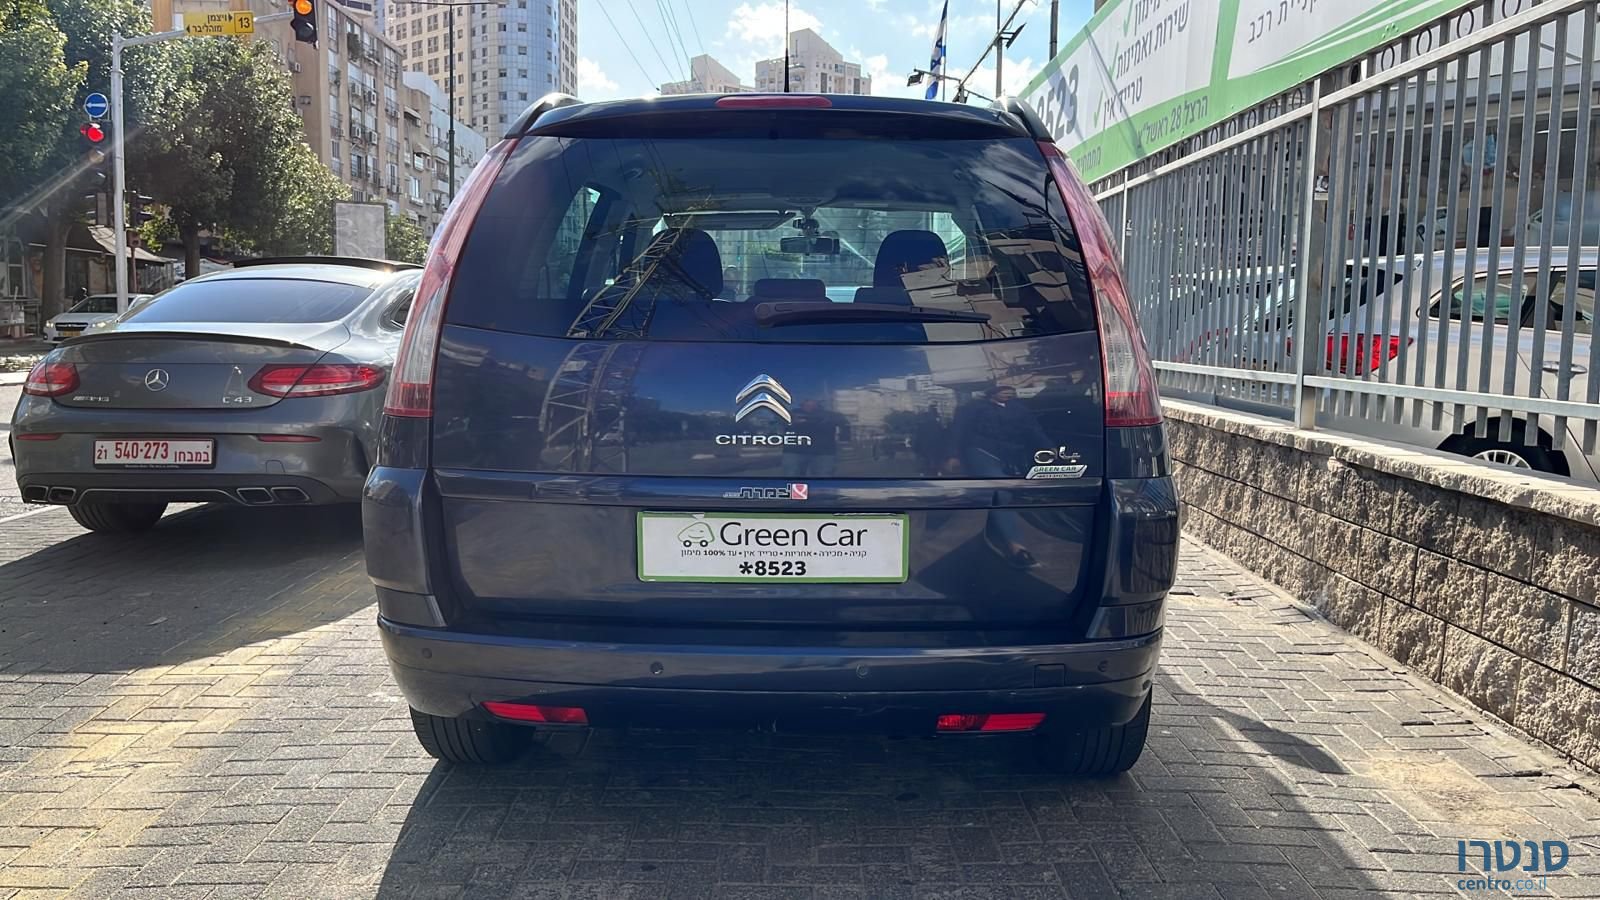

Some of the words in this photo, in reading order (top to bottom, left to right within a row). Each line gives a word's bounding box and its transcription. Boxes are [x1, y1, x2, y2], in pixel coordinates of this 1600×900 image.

[207, 14, 227, 24] ויצמן
[238, 17, 250, 29] 13
[192, 23, 222, 33] מוהליבר
[1154, 0, 1190, 52] שירות
[1248, 10, 1272, 44] רכב
[1116, 30, 1153, 80] ואמינות
[1119, 75, 1143, 113] טרייד
[1103, 95, 1118, 132] אין
[1184, 95, 1208, 126] הרצל
[1170, 107, 1182, 132] 28
[96, 449, 108, 460] 21
[173, 450, 210, 463] במבחן
[720, 521, 808, 547] Green
[817, 521, 868, 547] Car
[681, 549, 701, 558] מימון
[703, 549, 726, 557] 100%
[743, 550, 755, 558] אין
[849, 550, 867, 558] קניה
